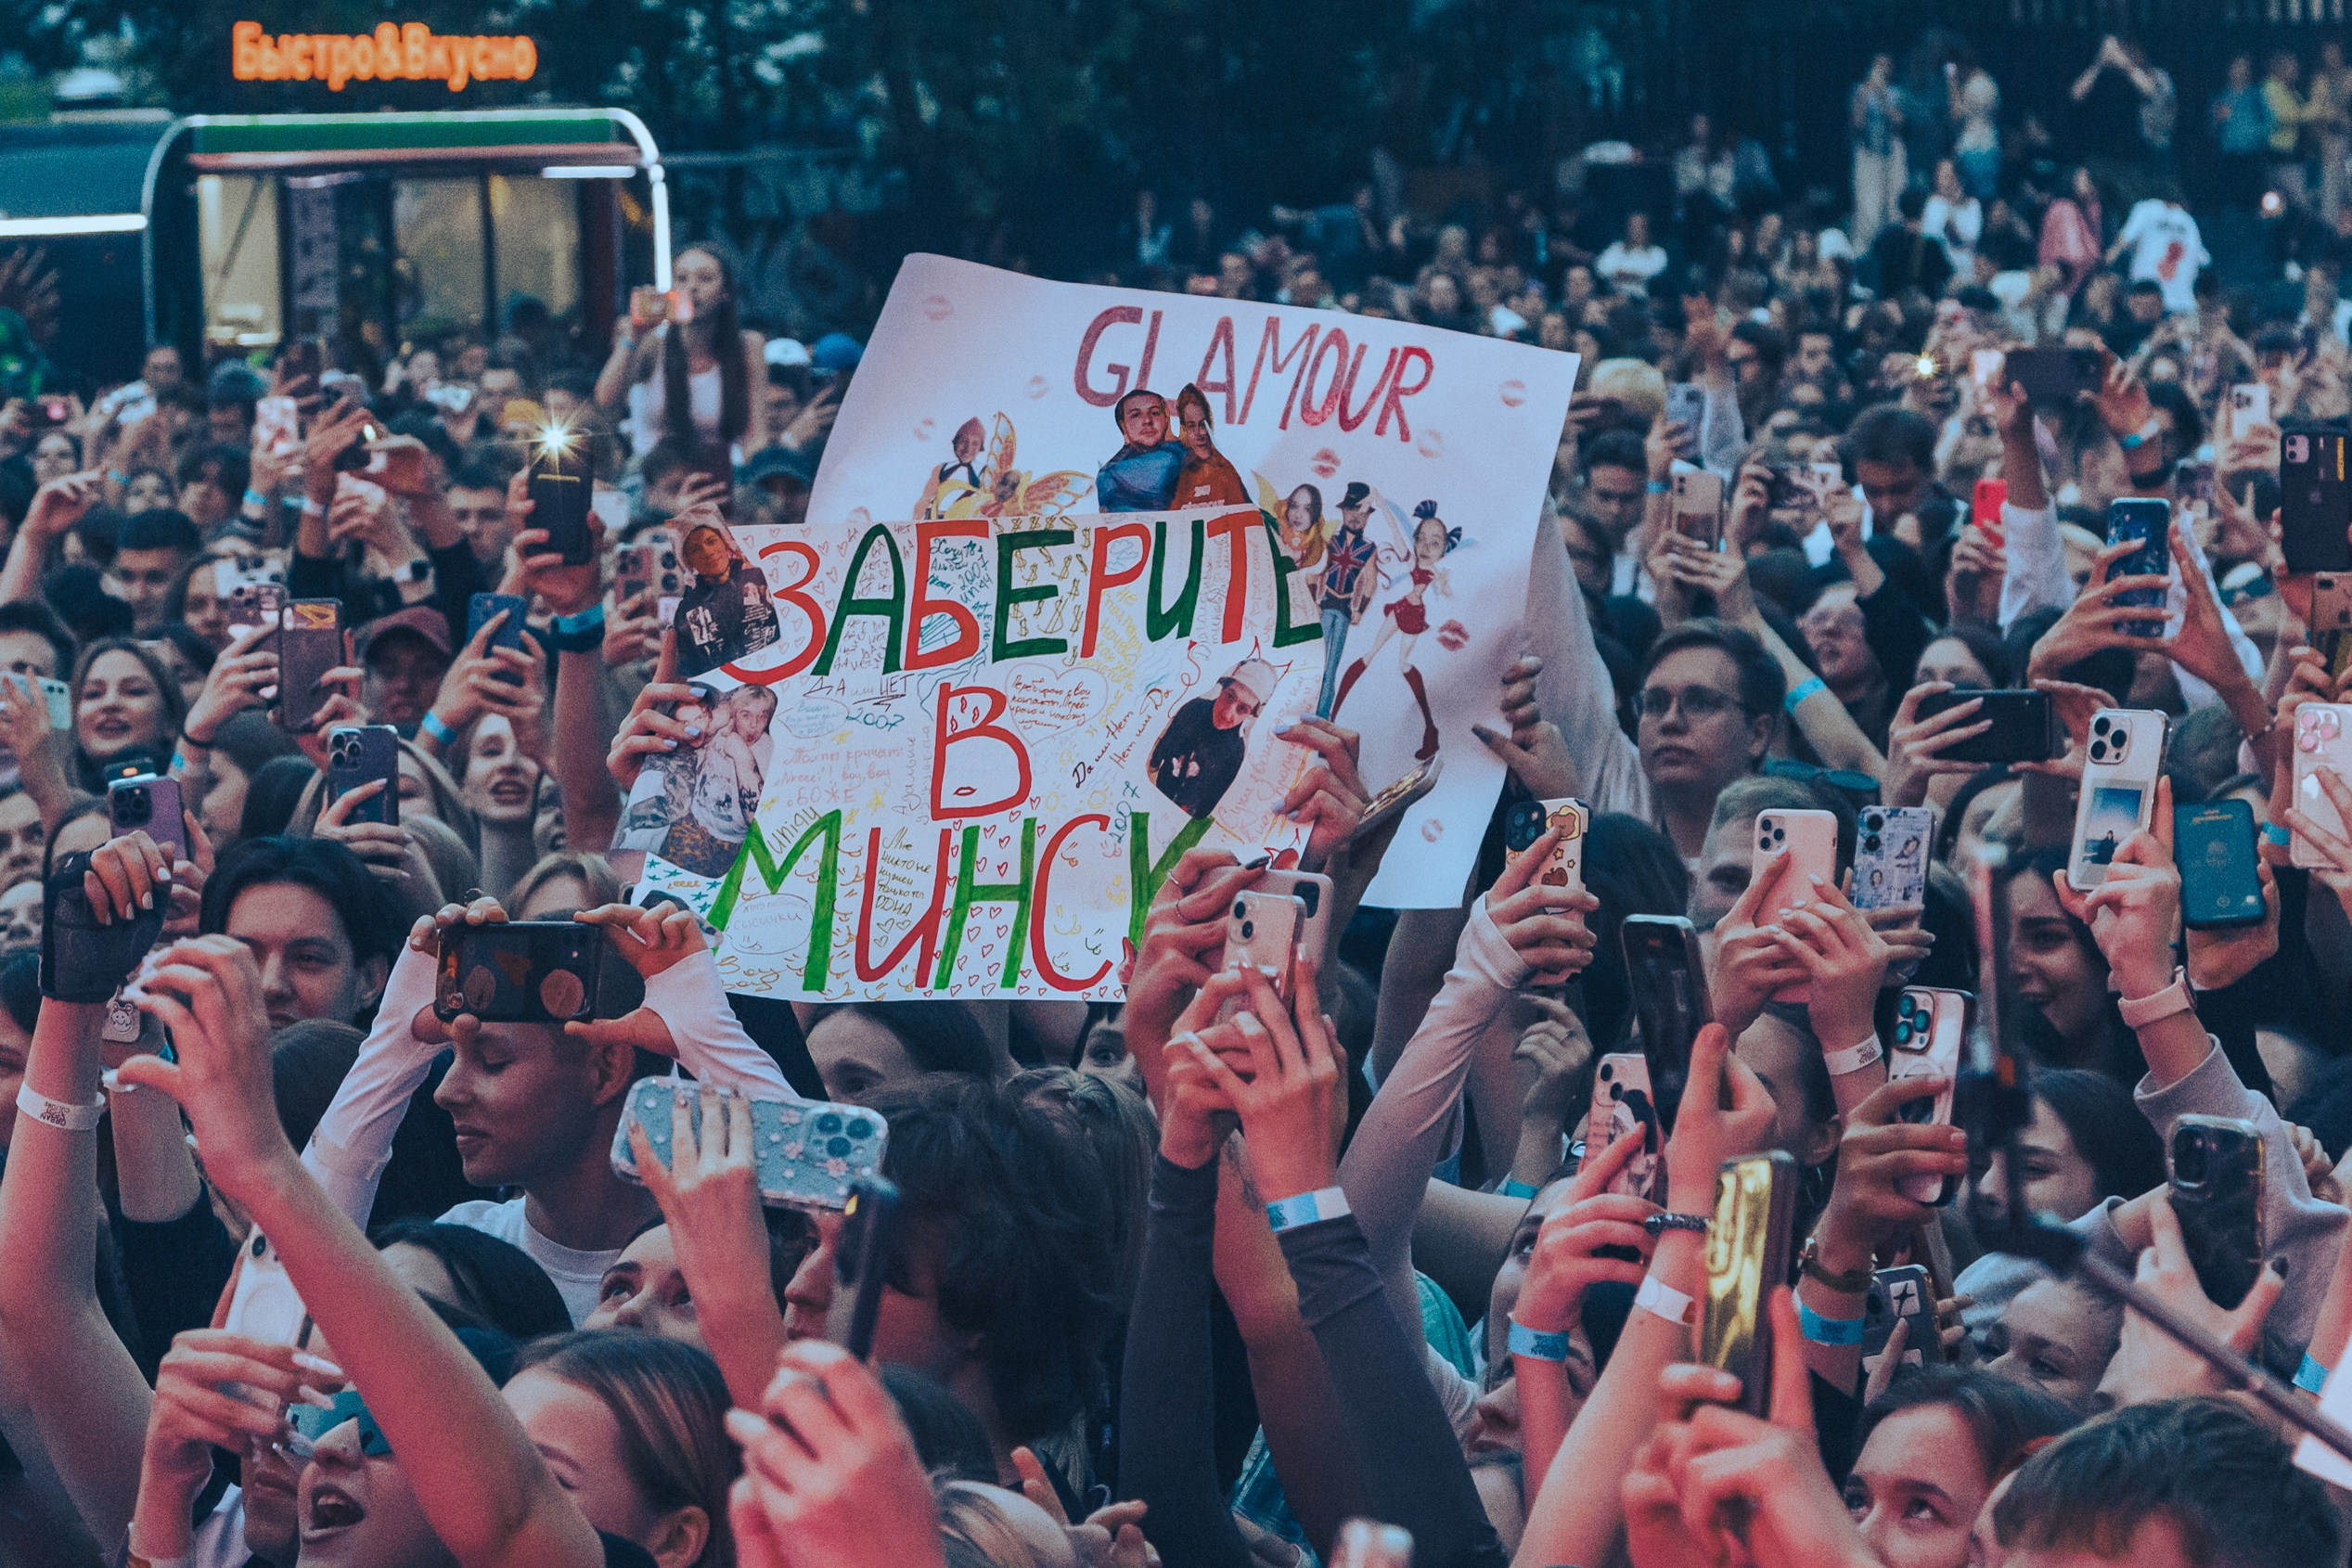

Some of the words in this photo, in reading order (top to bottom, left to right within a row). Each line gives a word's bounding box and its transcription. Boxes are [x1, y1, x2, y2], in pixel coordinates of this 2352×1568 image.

[1073, 304, 1434, 443] GLAMOUR
[720, 509, 1323, 689] ЗАБЕРИТЕ
[846, 707, 906, 732] 2007
[931, 682, 1033, 821] В
[1073, 761, 1094, 788] Да
[707, 807, 1215, 992] МИНСК
[882, 827, 912, 850] Мне
